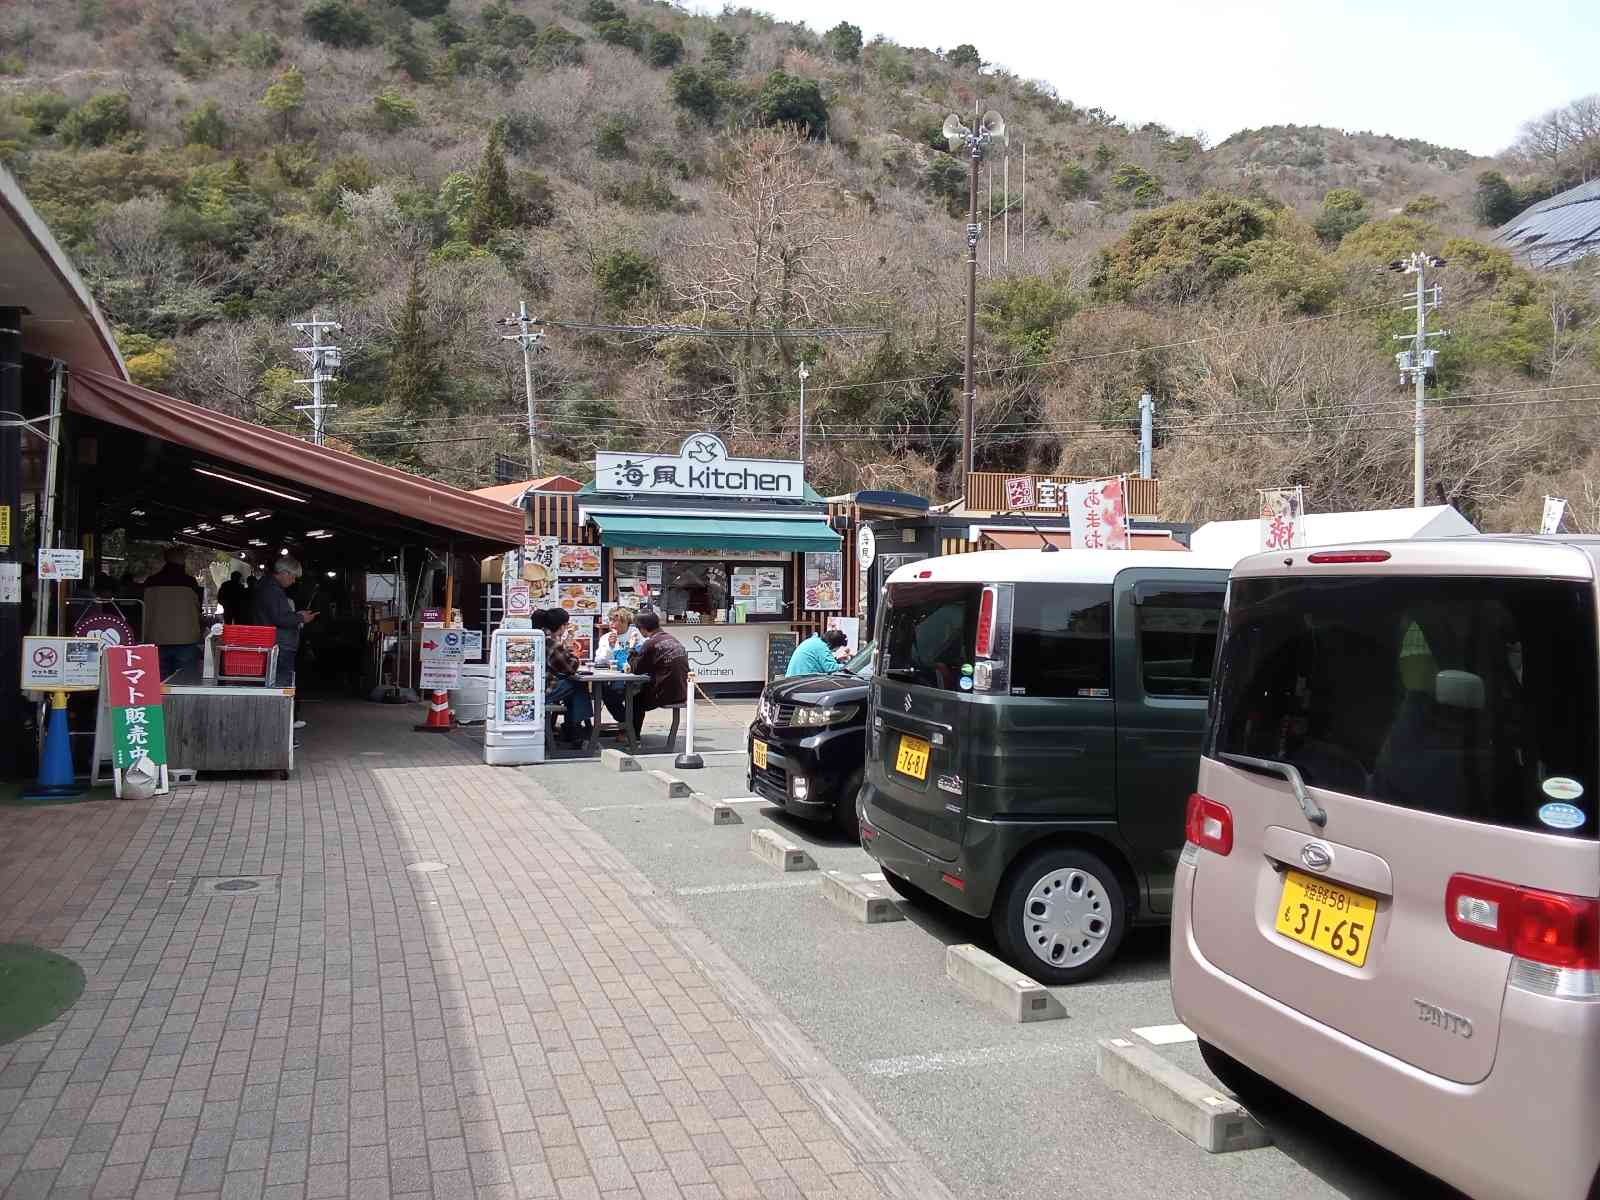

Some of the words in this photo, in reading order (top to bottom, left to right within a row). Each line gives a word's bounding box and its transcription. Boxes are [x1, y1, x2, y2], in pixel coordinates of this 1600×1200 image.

[614, 459, 685, 488] 海風
[689, 465, 792, 492] kitchen
[697, 667, 734, 676] kitchen
[121, 649, 151, 761] トマト販売中
[902, 750, 926, 776] 76-81
[1294, 902, 1364, 957] 31-65
